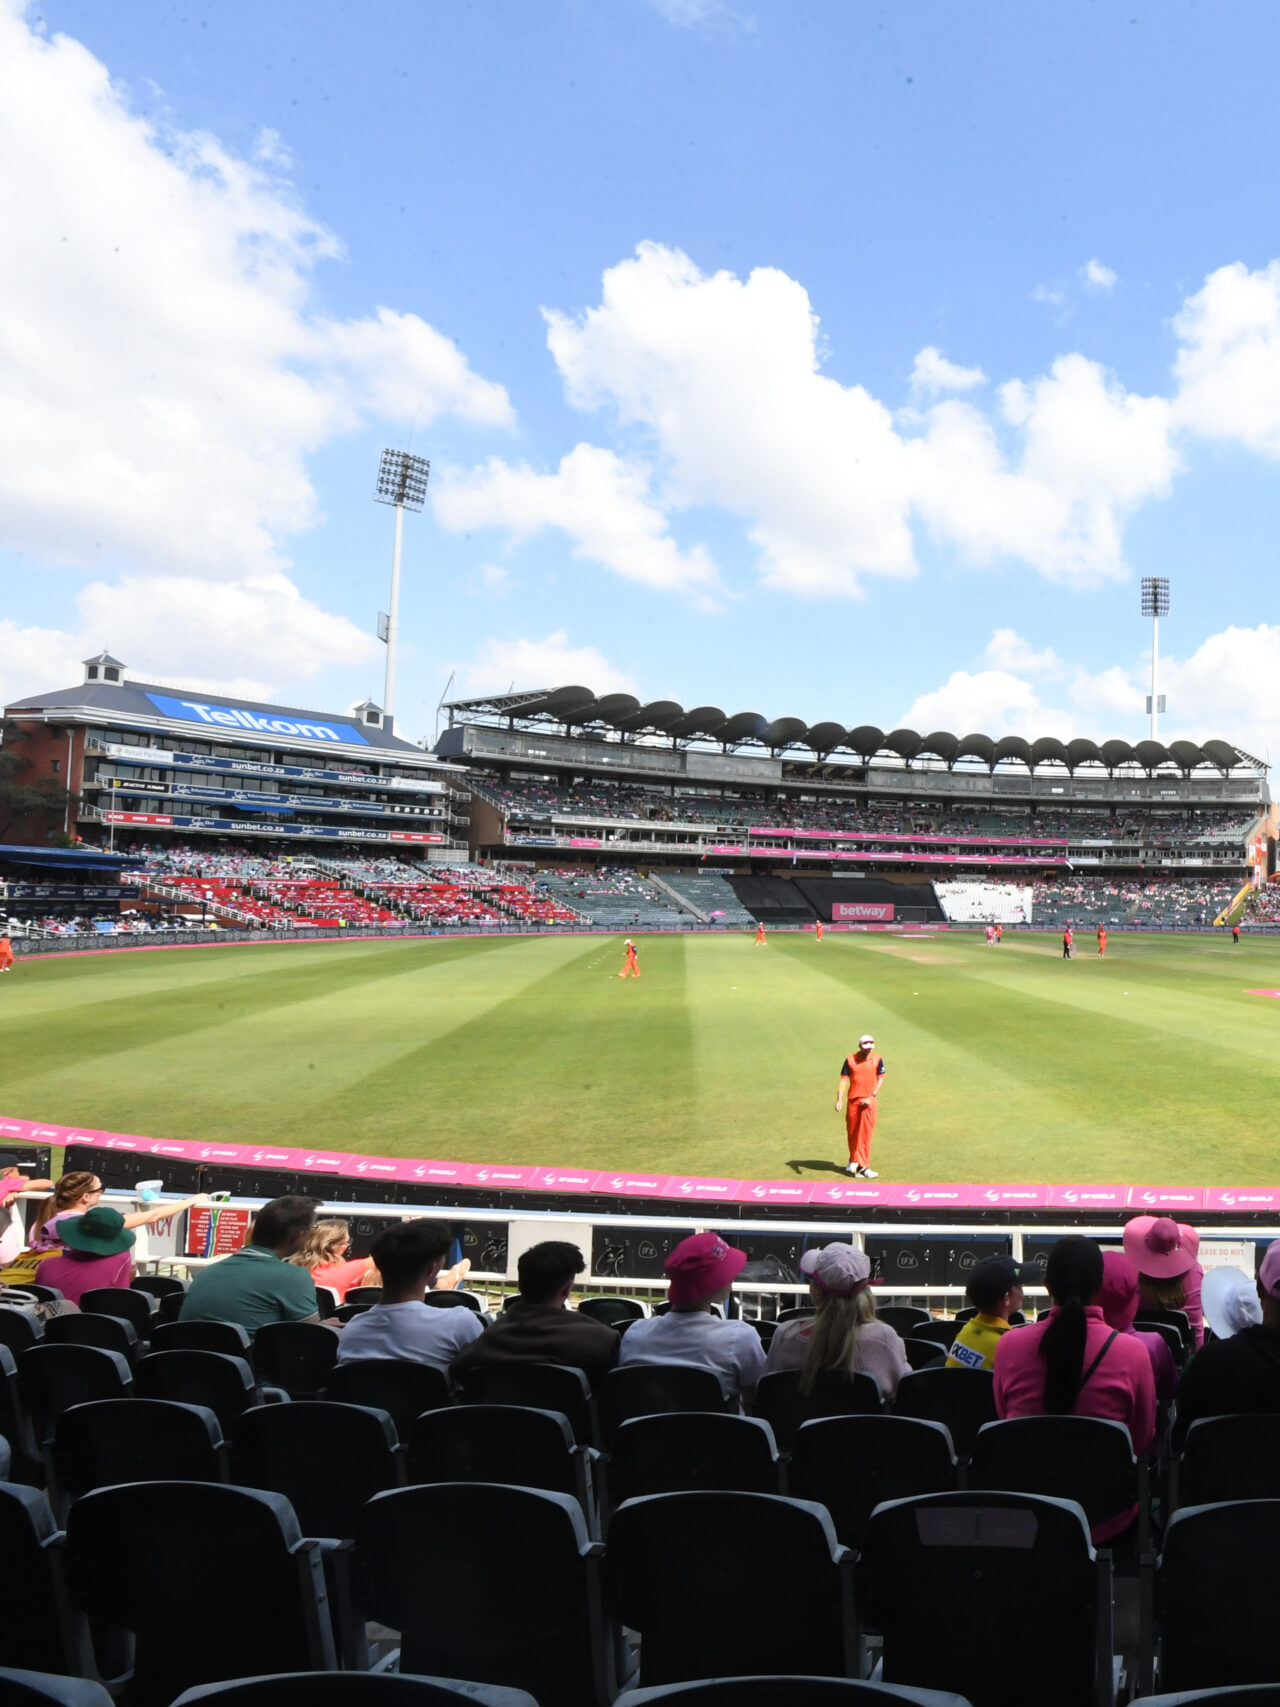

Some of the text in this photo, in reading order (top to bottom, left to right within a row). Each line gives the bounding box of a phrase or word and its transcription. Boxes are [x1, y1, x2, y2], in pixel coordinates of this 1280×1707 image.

[181, 702, 341, 741] Telkom
[232, 762, 285, 774] sunbet.co.za
[338, 774, 387, 785] sunbet.co.za
[231, 822, 284, 832] sunbet.co.za
[338, 830, 387, 839] sunbet.co.za
[839, 905, 887, 919] betway
[359, 1224, 371, 1233] IFX
[642, 1247, 655, 1256] IFX
[901, 1257, 914, 1265] IFX
[963, 1258, 977, 1266] IFX
